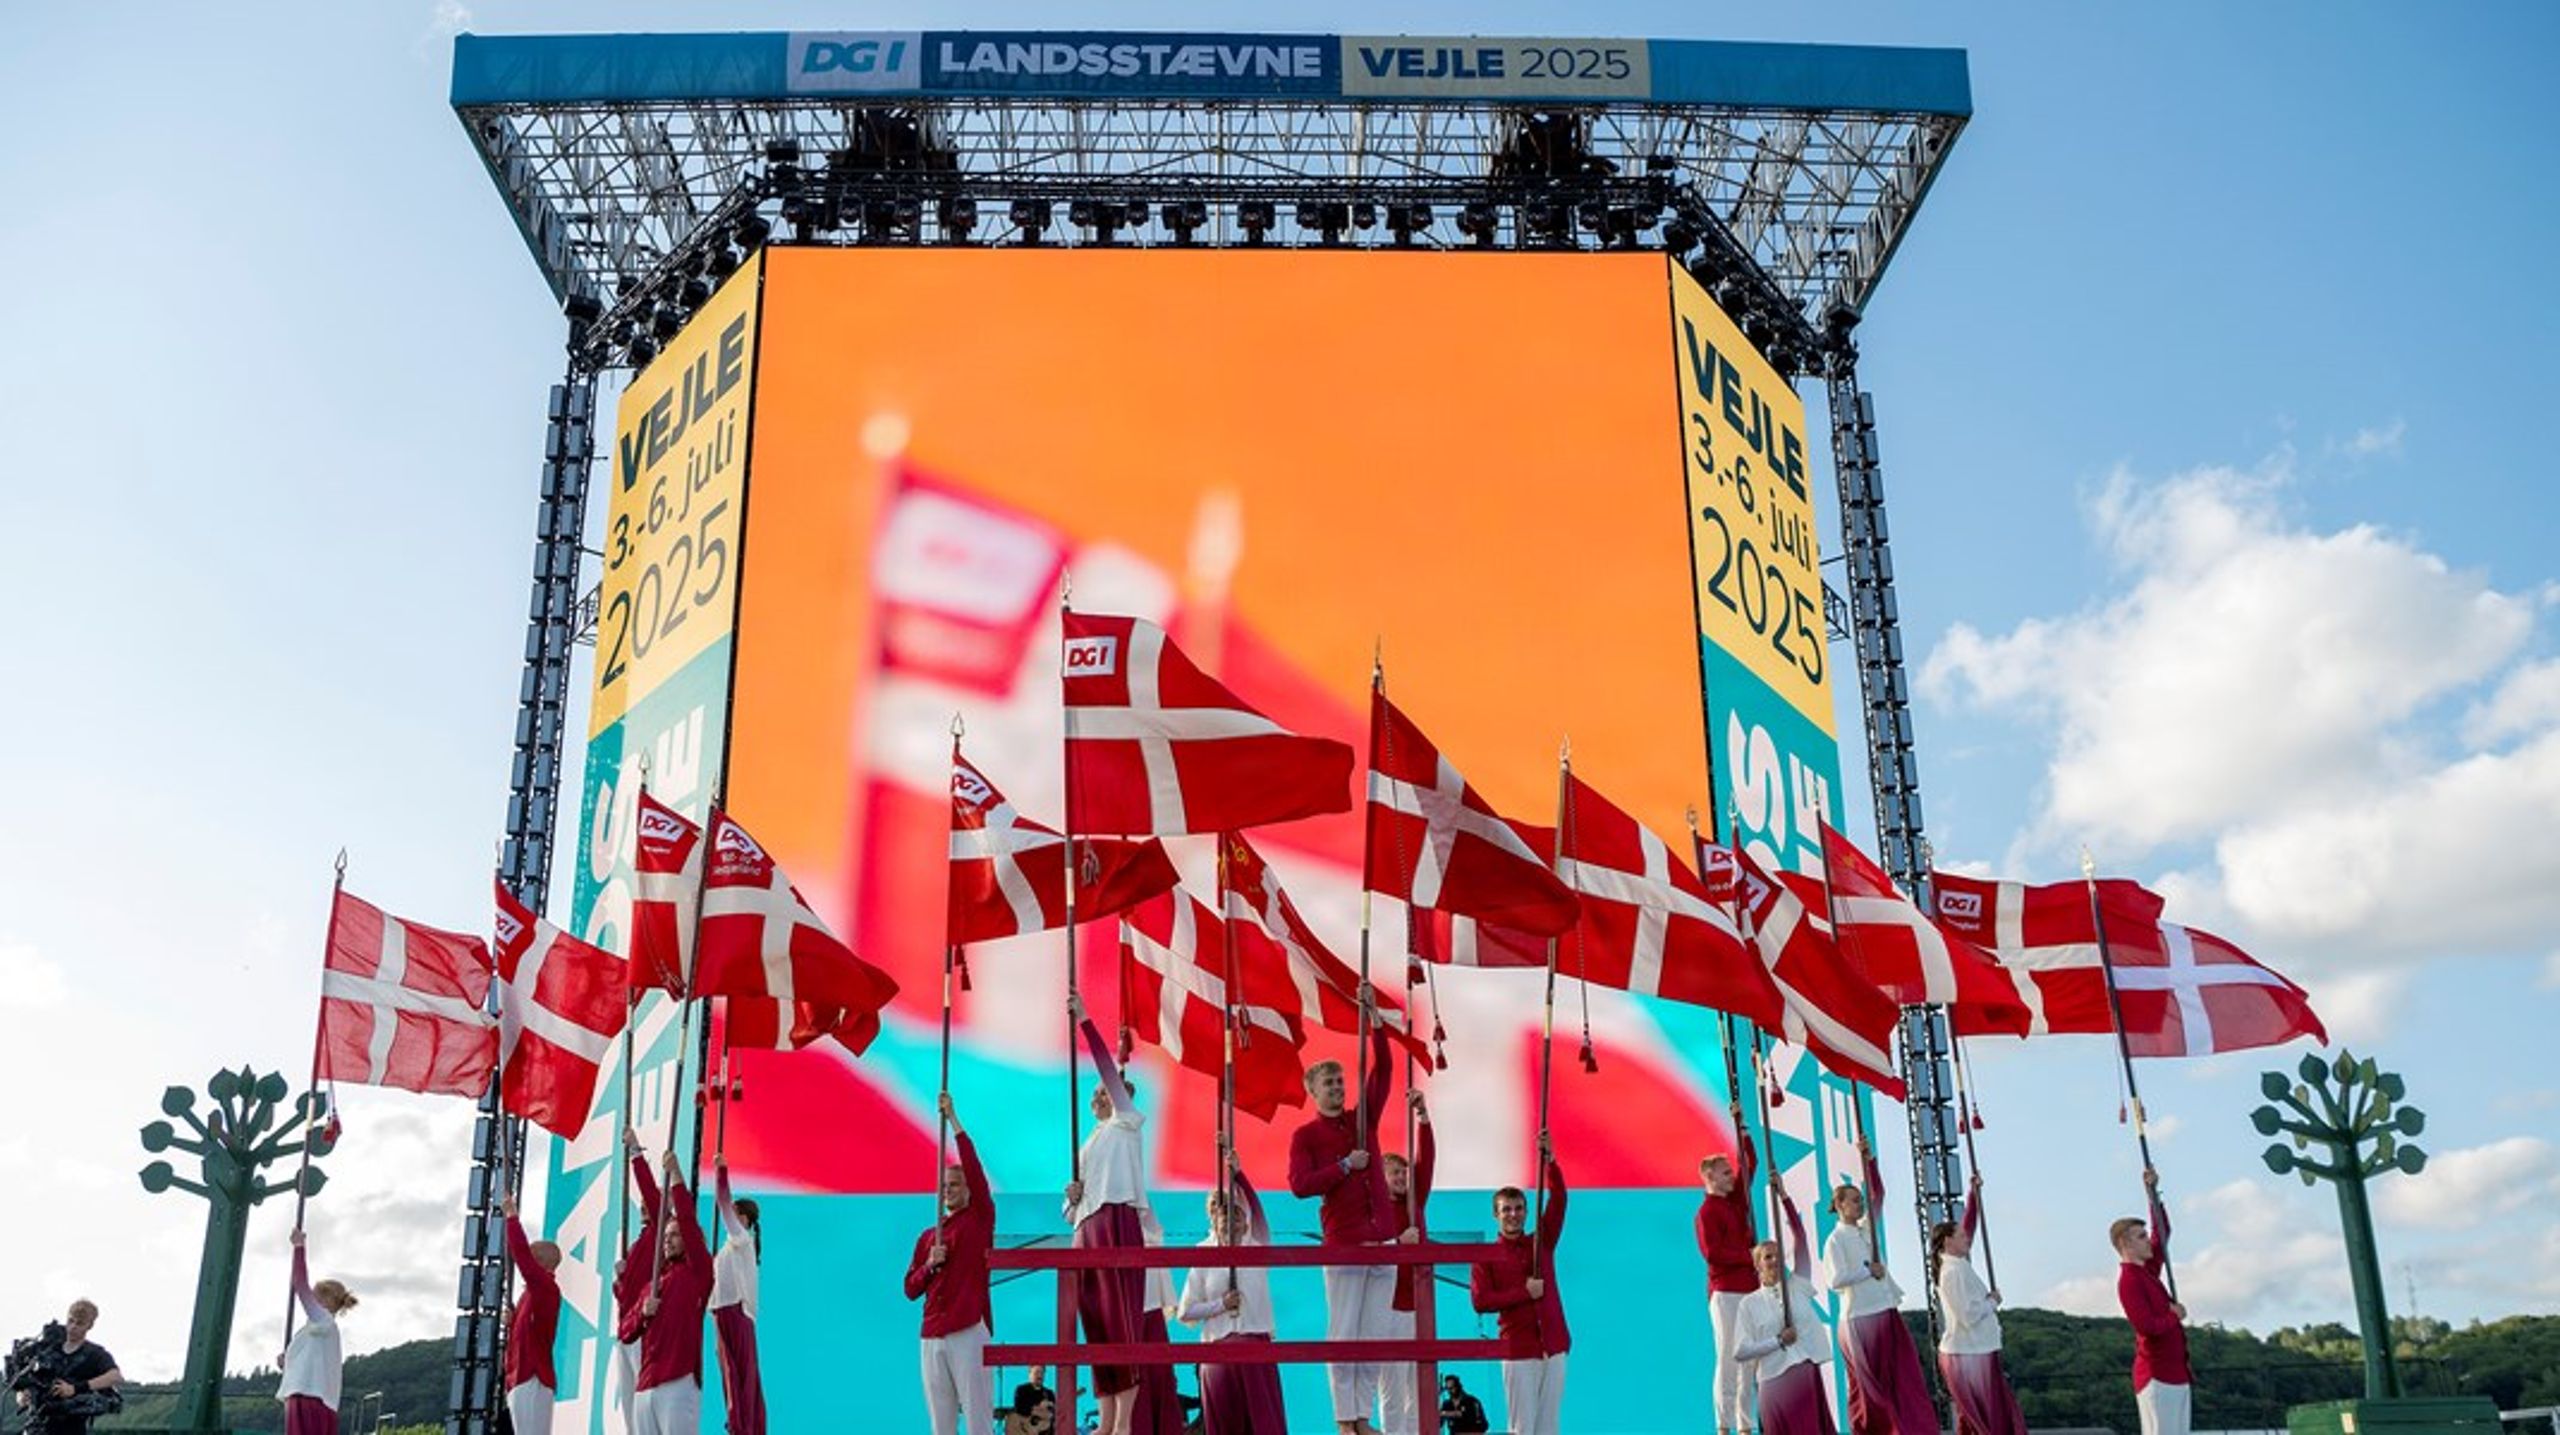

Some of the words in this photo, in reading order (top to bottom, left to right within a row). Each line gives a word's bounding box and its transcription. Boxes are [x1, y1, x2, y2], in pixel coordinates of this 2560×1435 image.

[802, 41, 907, 73] DGI
[940, 42, 1322, 78] LANDSSTÆVNE
[1359, 48, 1505, 78] VEJLE
[1521, 48, 1631, 80] 2025
[620, 311, 747, 492] VEJLE
[1683, 315, 1808, 503] VEJLE
[679, 408, 736, 521] juli
[1769, 488, 1812, 573] juli
[601, 499, 729, 691] 2025
[1703, 506, 1823, 686] 2025
[1068, 646, 1109, 668] DGI
[643, 815, 680, 834] DGI
[1943, 896, 1977, 912] DGI
